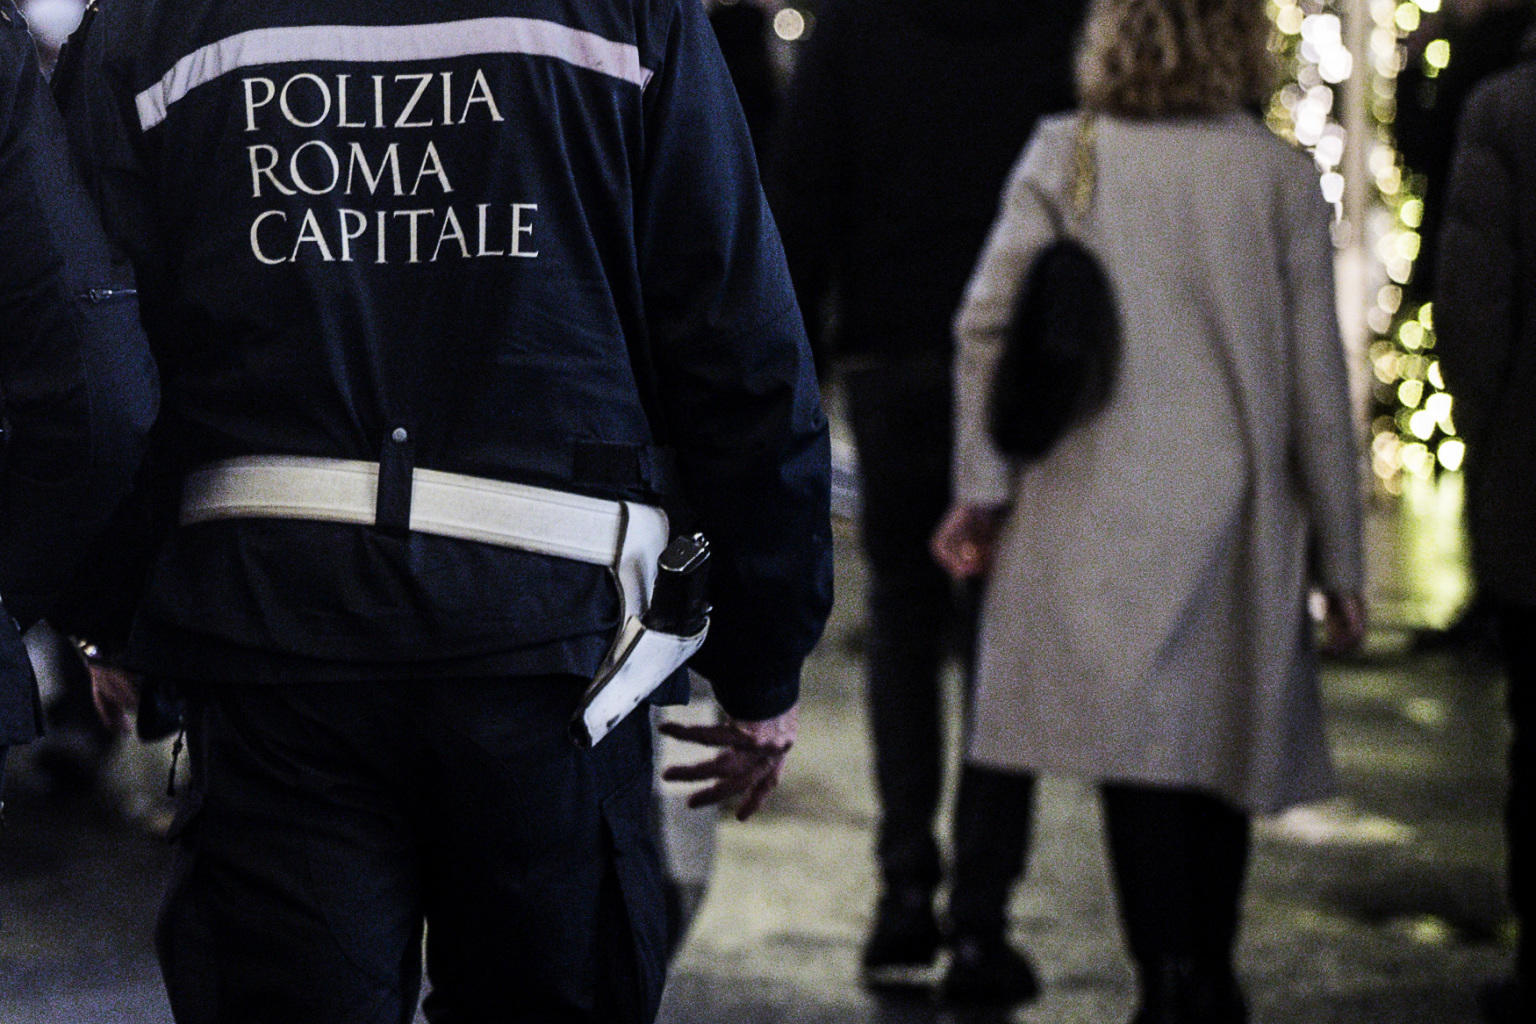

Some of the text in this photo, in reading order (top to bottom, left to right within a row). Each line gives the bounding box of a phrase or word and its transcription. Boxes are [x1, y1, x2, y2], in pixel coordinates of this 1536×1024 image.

[241, 68, 505, 132] POLIZIA
[246, 140, 455, 198] ROMA
[250, 203, 540, 265] CAPITALE
